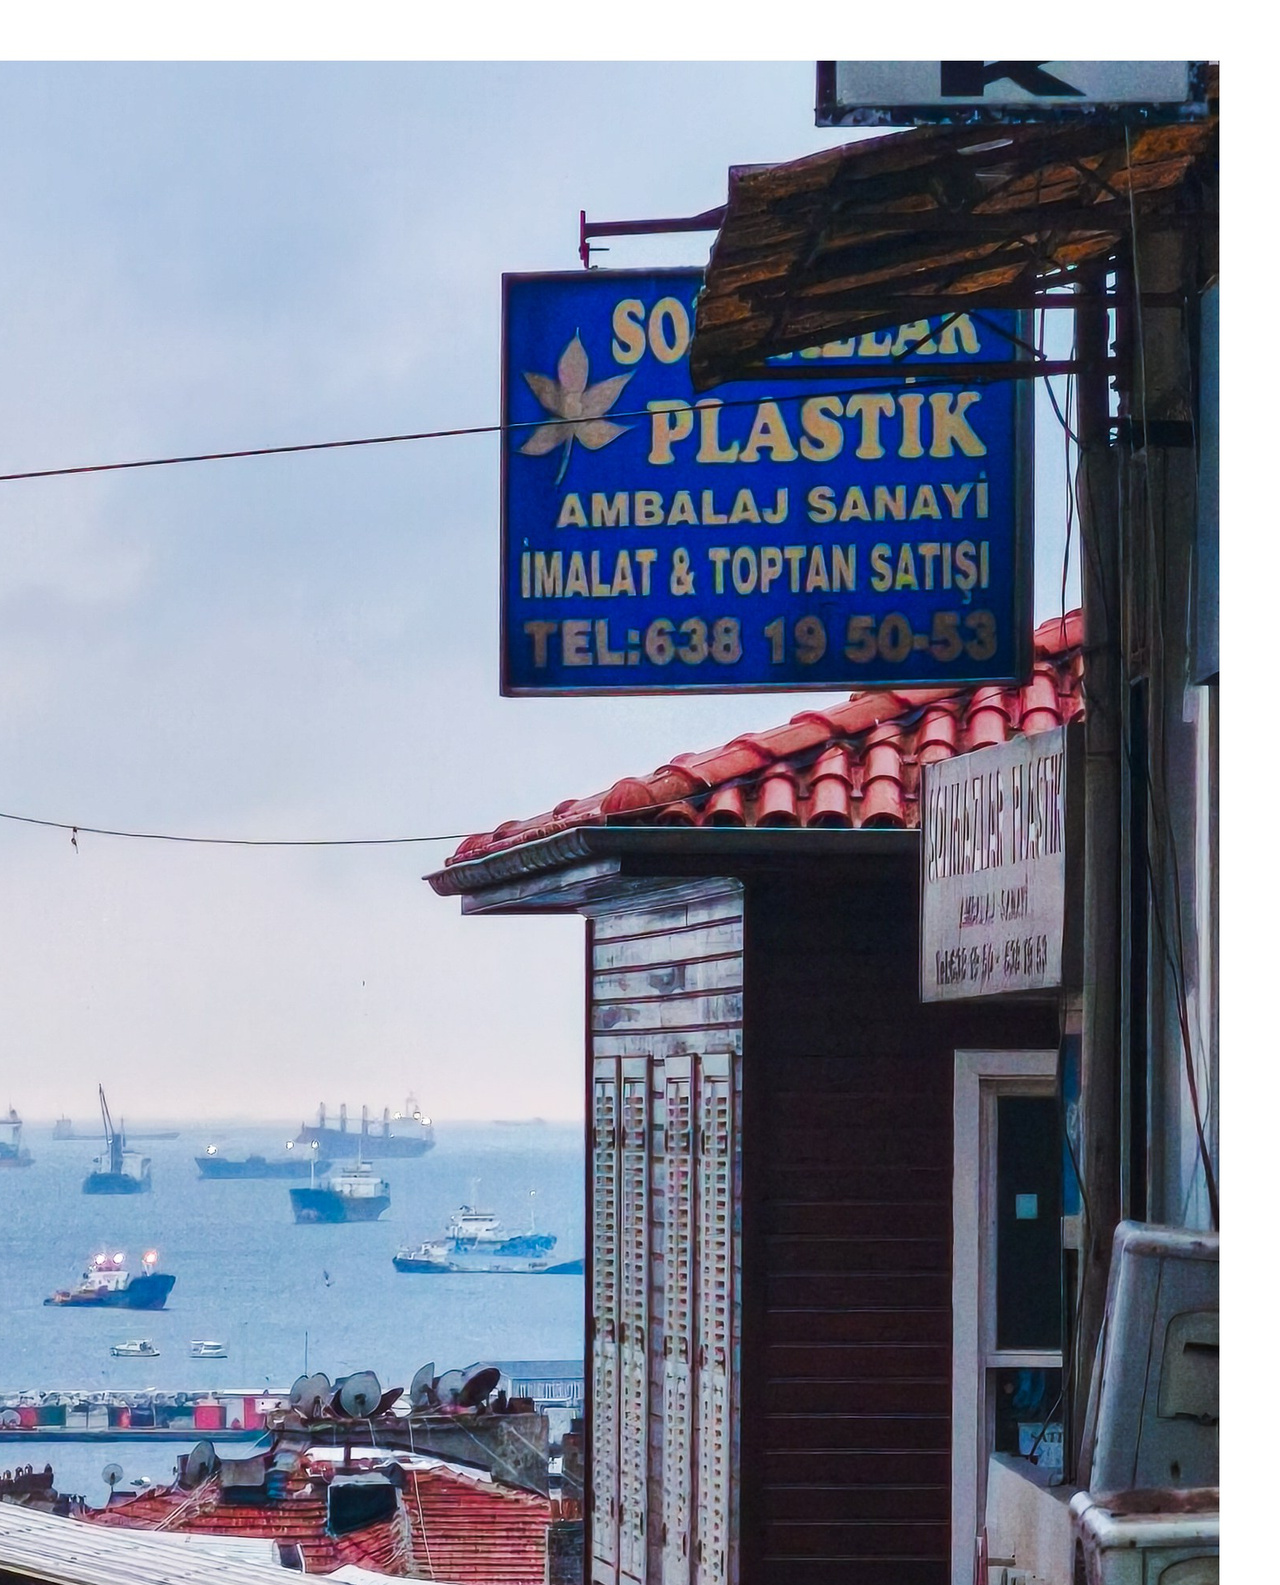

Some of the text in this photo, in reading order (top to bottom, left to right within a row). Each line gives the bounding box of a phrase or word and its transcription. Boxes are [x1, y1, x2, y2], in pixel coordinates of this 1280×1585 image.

[557, 471, 989, 529] AMBALAJ SANAYİ
[522, 538, 990, 604] İMALAT & TOPTAN SATIŞI
[763, 612, 827, 665] 19
[844, 609, 999, 664] 50-53
